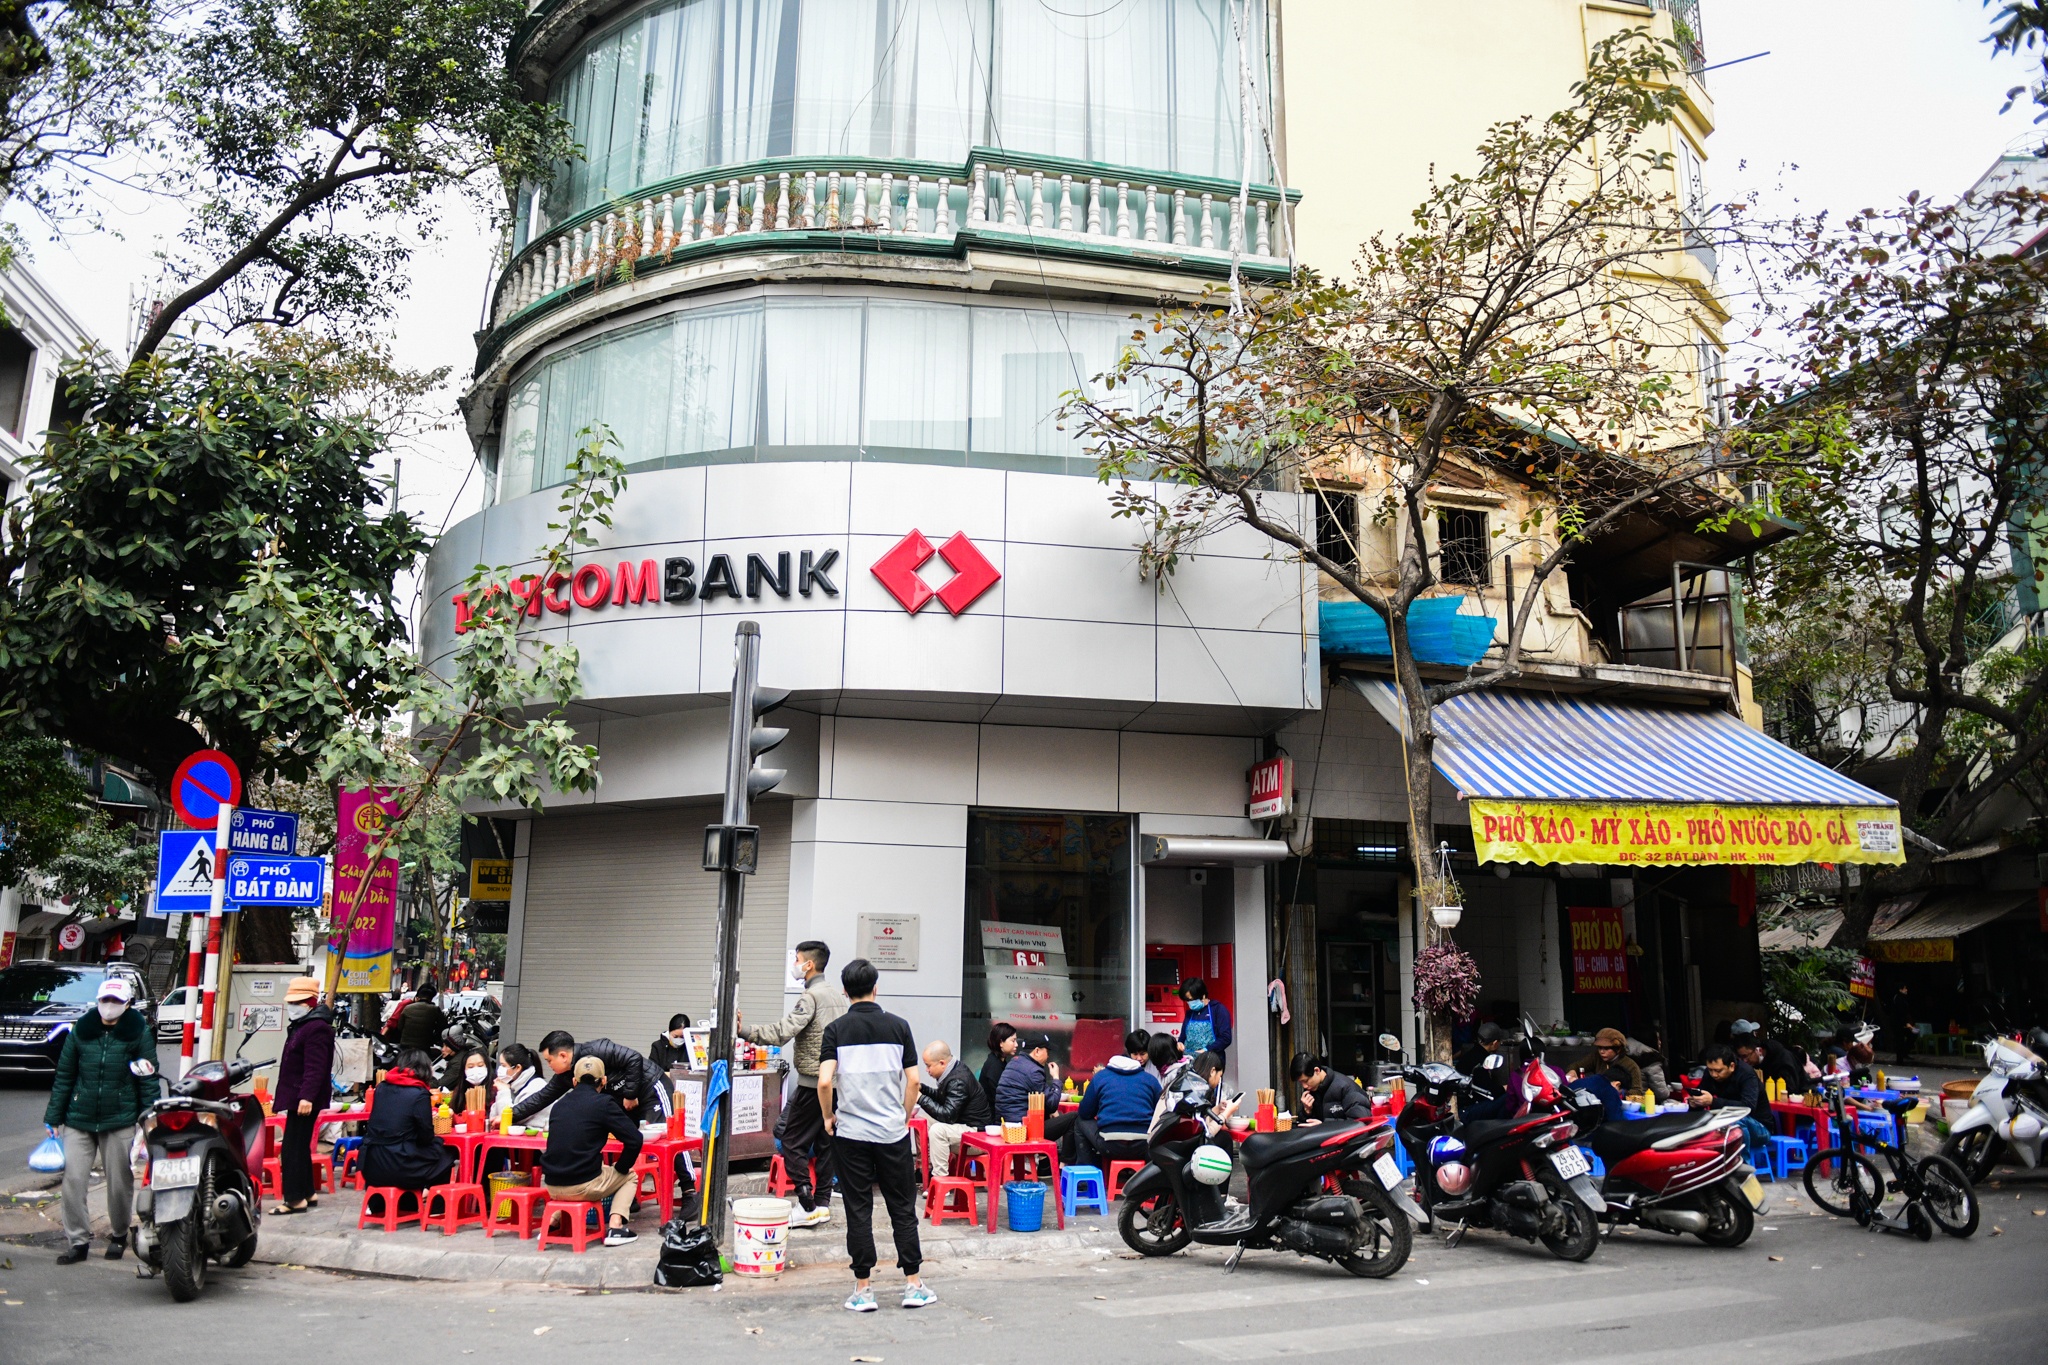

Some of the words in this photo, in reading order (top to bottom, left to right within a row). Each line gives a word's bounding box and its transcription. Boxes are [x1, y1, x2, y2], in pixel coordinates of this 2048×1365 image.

[452, 548, 840, 635] THCOMBANK
[1252, 764, 1278, 796] ATM
[251, 817, 275, 829] PHỐ
[1482, 805, 1526, 843] PHỞ
[1532, 809, 1575, 844] XÀO
[1628, 811, 1671, 845] XÀO
[1686, 808, 1726, 846] PHỞ
[1728, 812, 1783, 846] NƯỚC
[1785, 813, 1813, 846] BÒ
[1826, 813, 1852, 846] GÀ
[232, 828, 268, 849] HÀNG
[271, 832, 288, 851] GÀ
[1619, 852, 1640, 862] ĐC:
[1645, 852, 1661, 862] 32
[1666, 850, 1689, 862] BÁT
[1692, 850, 1719, 862] ĐÀN
[1730, 853, 1746, 862] HK
[1758, 853, 1775, 862] HN
[259, 863, 291, 876] PHỐ
[339, 864, 365, 879] Chào
[235, 876, 271, 897] BÁT
[274, 877, 313, 898] ĐÀN
[369, 887, 390, 905] Dần
[351, 916, 377, 930] 022
[1571, 909, 1600, 950] PHỞ
[1602, 912, 1623, 950] BÒ
[1014, 938, 1031, 946] kiệm
[1016, 952, 1028, 967] 6
[1574, 953, 1586, 973] TÁI
[1591, 953, 1609, 973] CHÍN
[1614, 953, 1625, 972] GÀ
[347, 979, 371, 987] Bank
[1579, 976, 1614, 990] 50.000
[1556, 1149, 1579, 1166] 29-G1
[1560, 1159, 1586, 1177] 697.57
